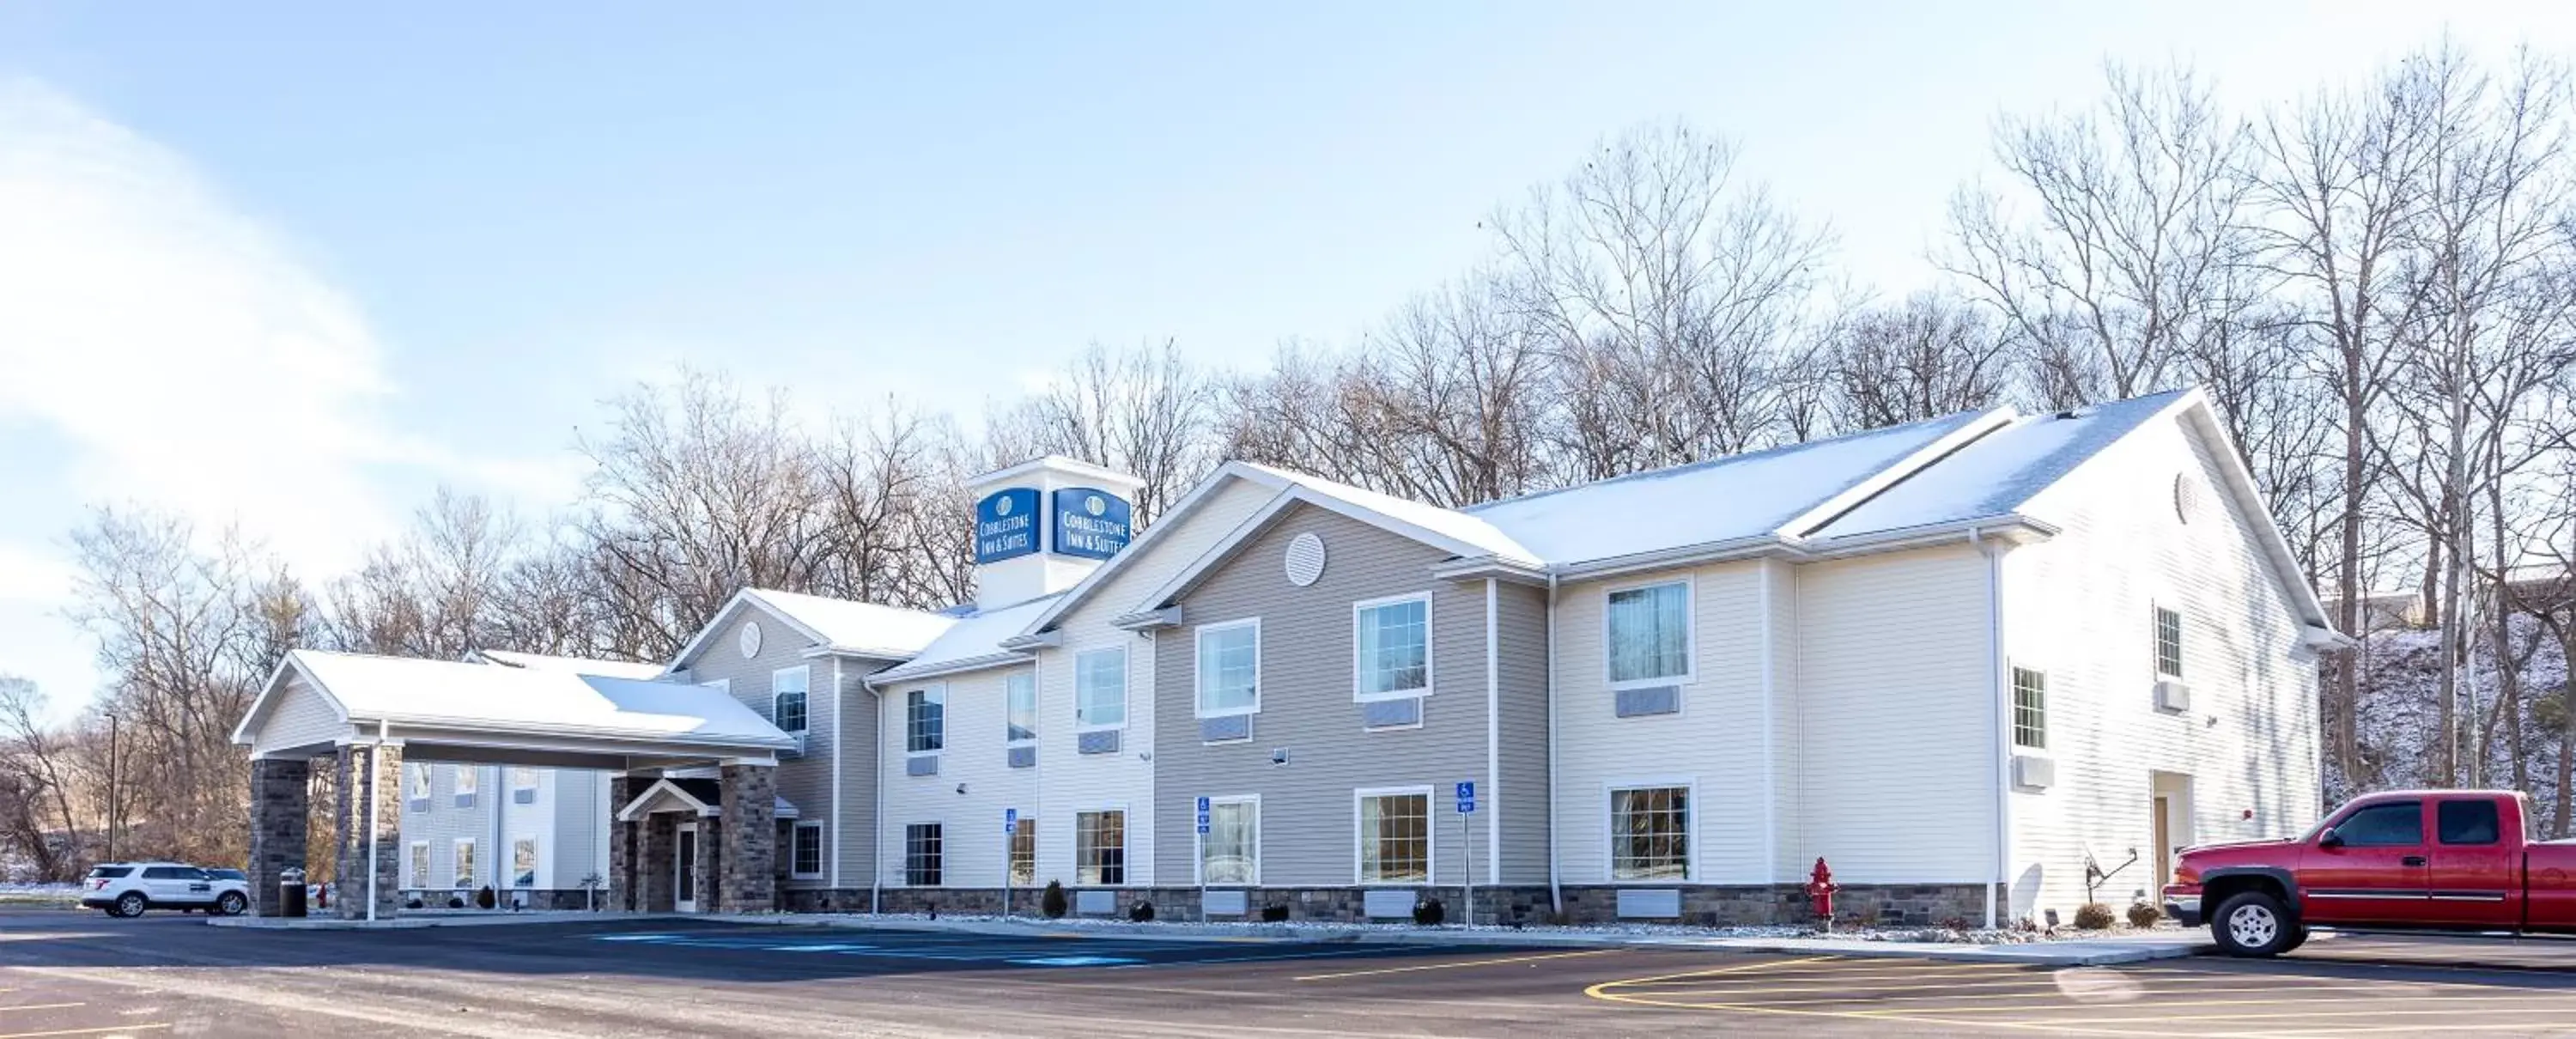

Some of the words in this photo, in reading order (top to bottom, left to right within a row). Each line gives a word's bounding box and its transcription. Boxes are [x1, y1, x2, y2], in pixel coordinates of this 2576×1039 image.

[980, 513, 1030, 537] COBBLESTONE
[1064, 511, 1127, 537] COBBLESTONE
[996, 537, 1002, 552] &
[1066, 530, 1083, 548] INN
[1085, 535, 1093, 550] &
